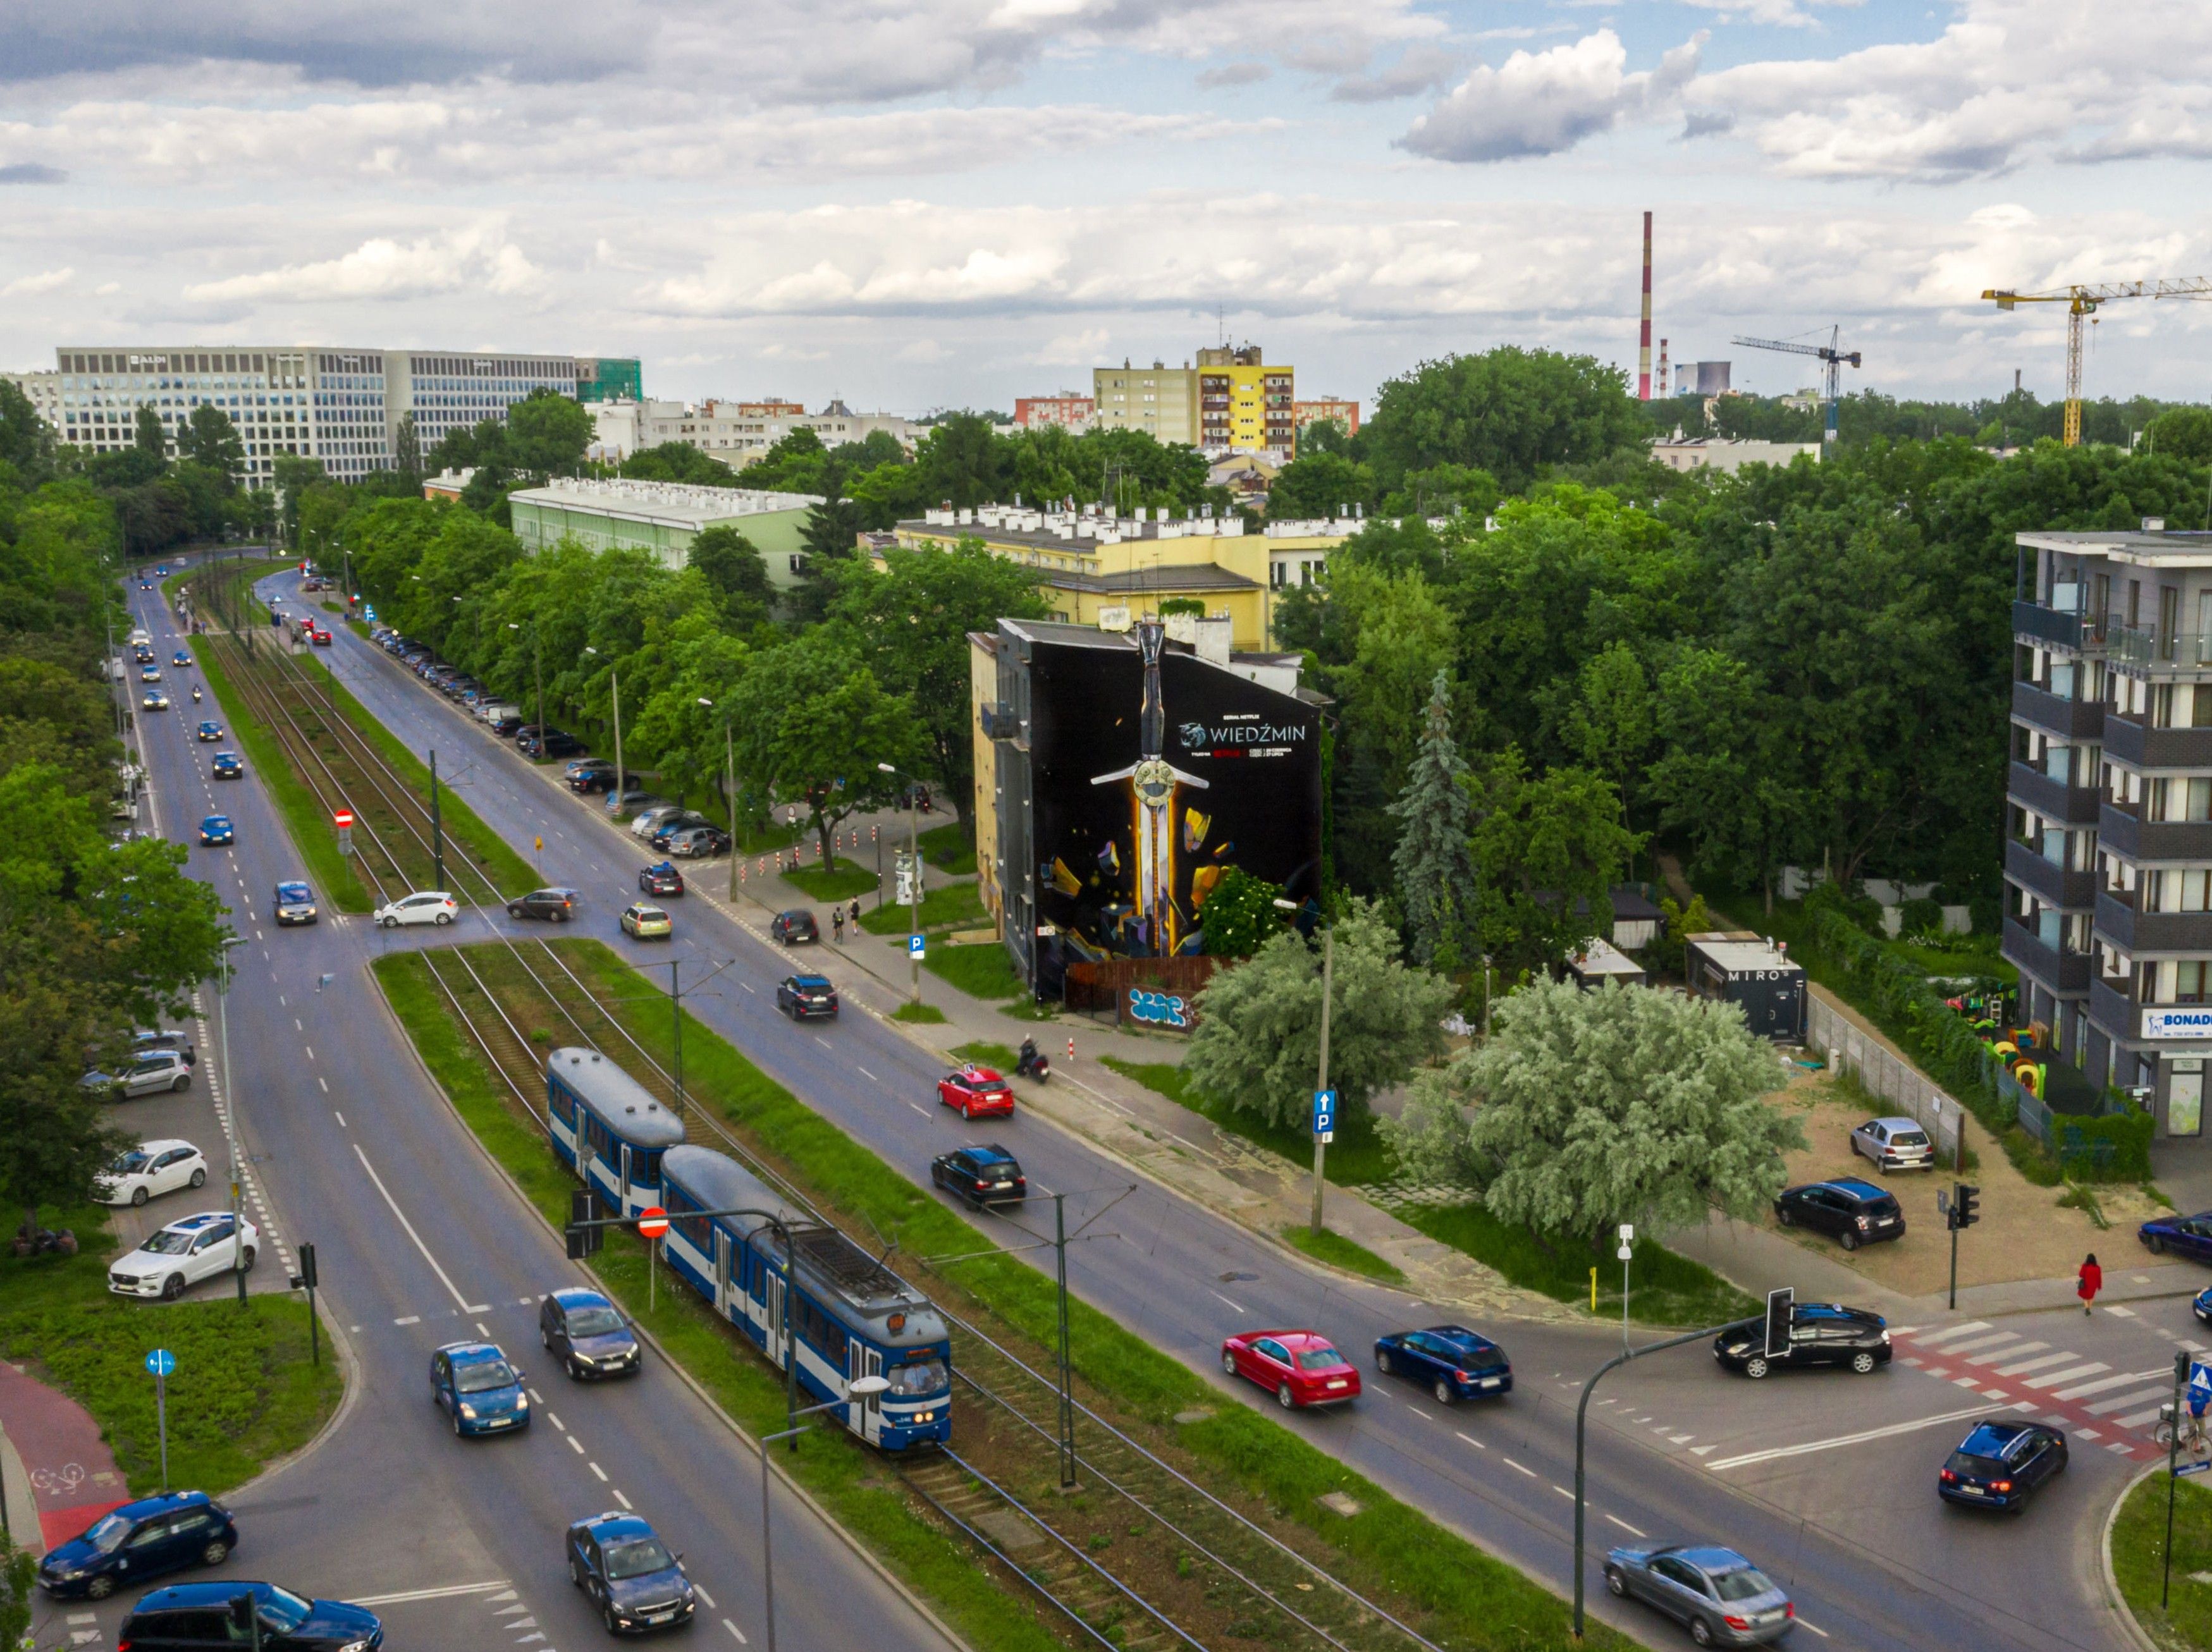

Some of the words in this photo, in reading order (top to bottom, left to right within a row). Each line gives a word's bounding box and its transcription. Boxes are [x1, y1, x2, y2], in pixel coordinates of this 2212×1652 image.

[1210, 723, 1305, 743] WIEDŹMIN
[912, 937, 921, 950] P
[2164, 1015, 2212, 1025] BONAD
[1318, 1115, 1329, 1130] P
